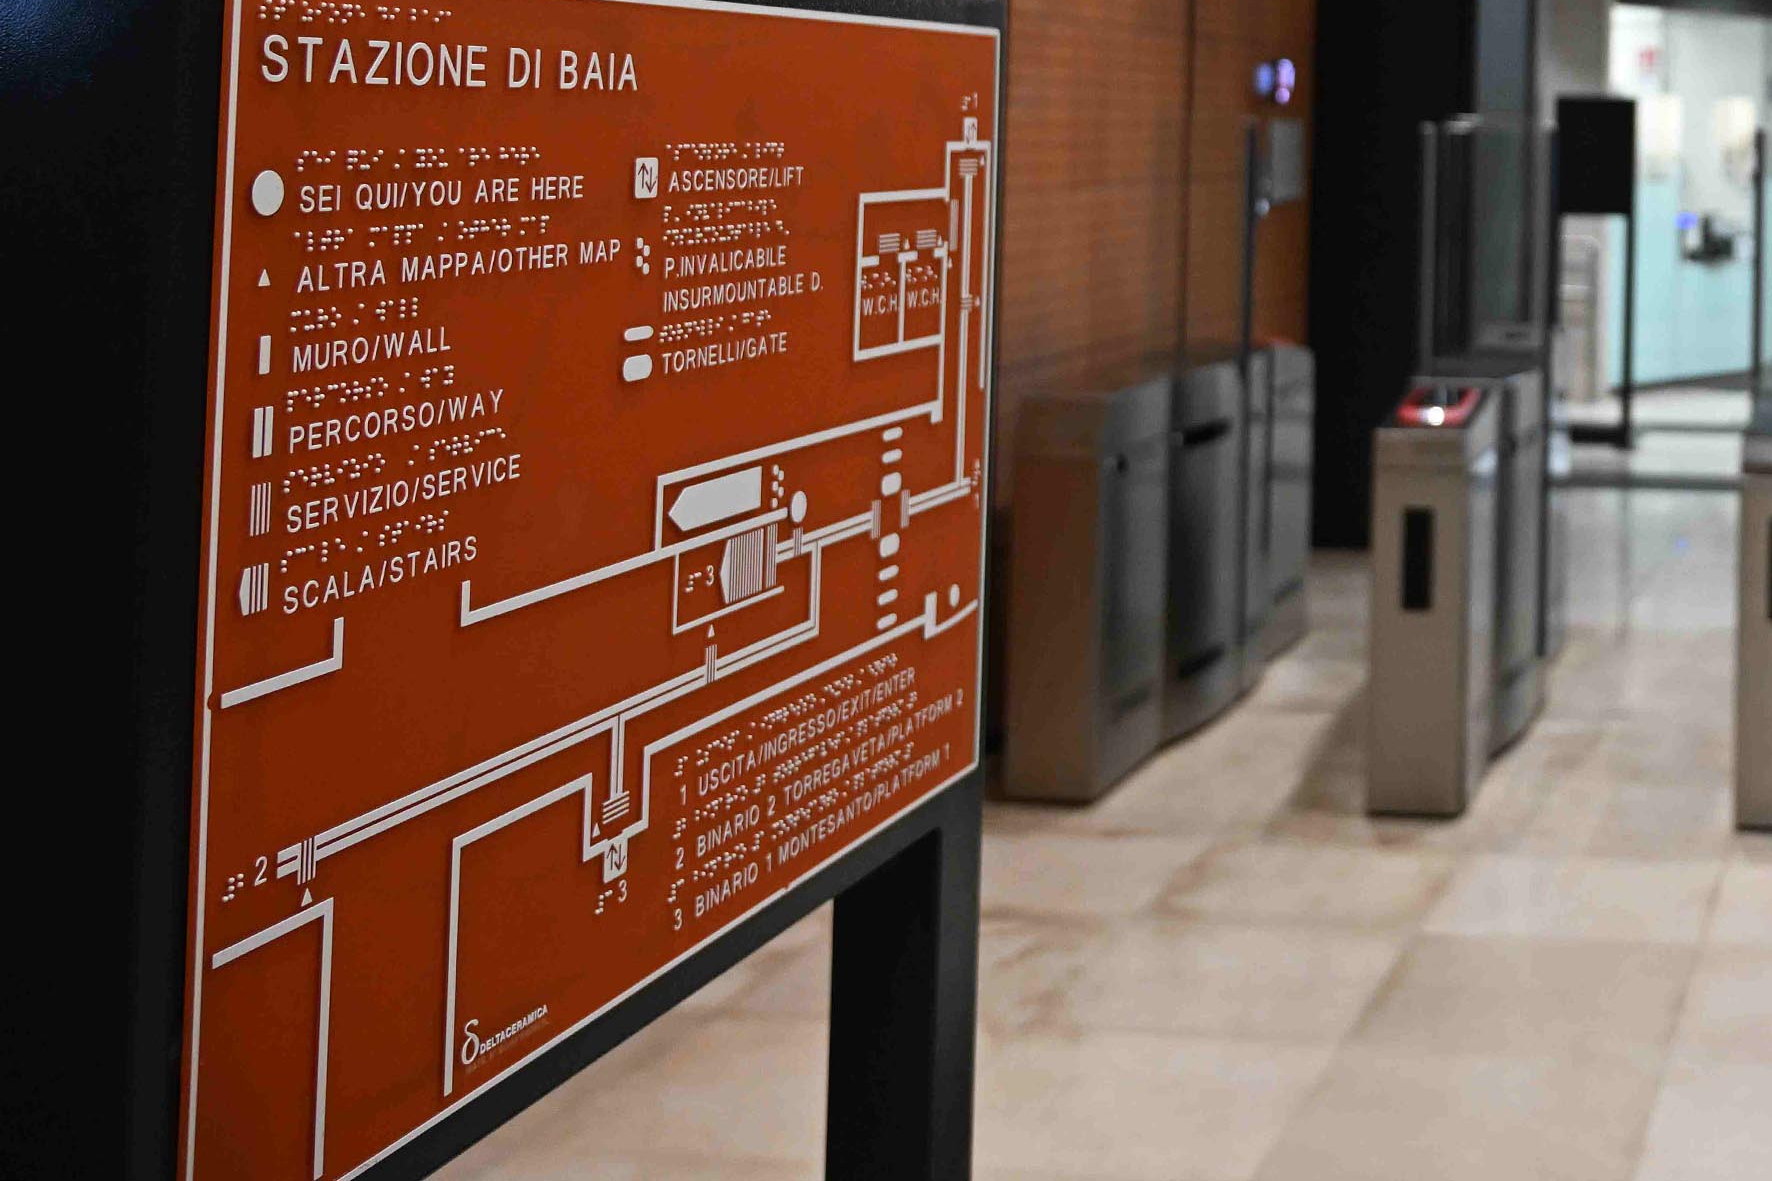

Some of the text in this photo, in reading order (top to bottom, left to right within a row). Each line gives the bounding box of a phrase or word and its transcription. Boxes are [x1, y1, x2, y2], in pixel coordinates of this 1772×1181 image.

[262, 34, 639, 92] STAZIONE DI BAIA
[299, 175, 585, 214] SEI QUI/YOU ARE HERE
[668, 166, 805, 193] ASCENSORE/LIFT
[296, 240, 622, 295] ALTRA MAPPA/OTHER MAP
[665, 245, 787, 279] P.INVALICABILE
[663, 274, 805, 313] INSURMOUNTABLE
[292, 325, 452, 374] MURO/WALL
[662, 332, 788, 374] TORNELLI/GATE
[288, 388, 504, 454] PERCORSO/WAY
[285, 454, 522, 536] SERVIZIO/SERVICE
[282, 535, 479, 615] SCALA/STAIRS
[705, 565, 715, 587] 3
[675, 688, 964, 870] 2 BINARIO 2 TORREGAVETA/PLATFORM 2
[680, 784, 688, 806] 1
[673, 742, 950, 932] 3 BINARIO 1 MONTESANTO/PLATFORM 1
[253, 855, 268, 887] 2
[617, 880, 629, 903] 3
[479, 1004, 549, 1055] DELTACERAMICA
